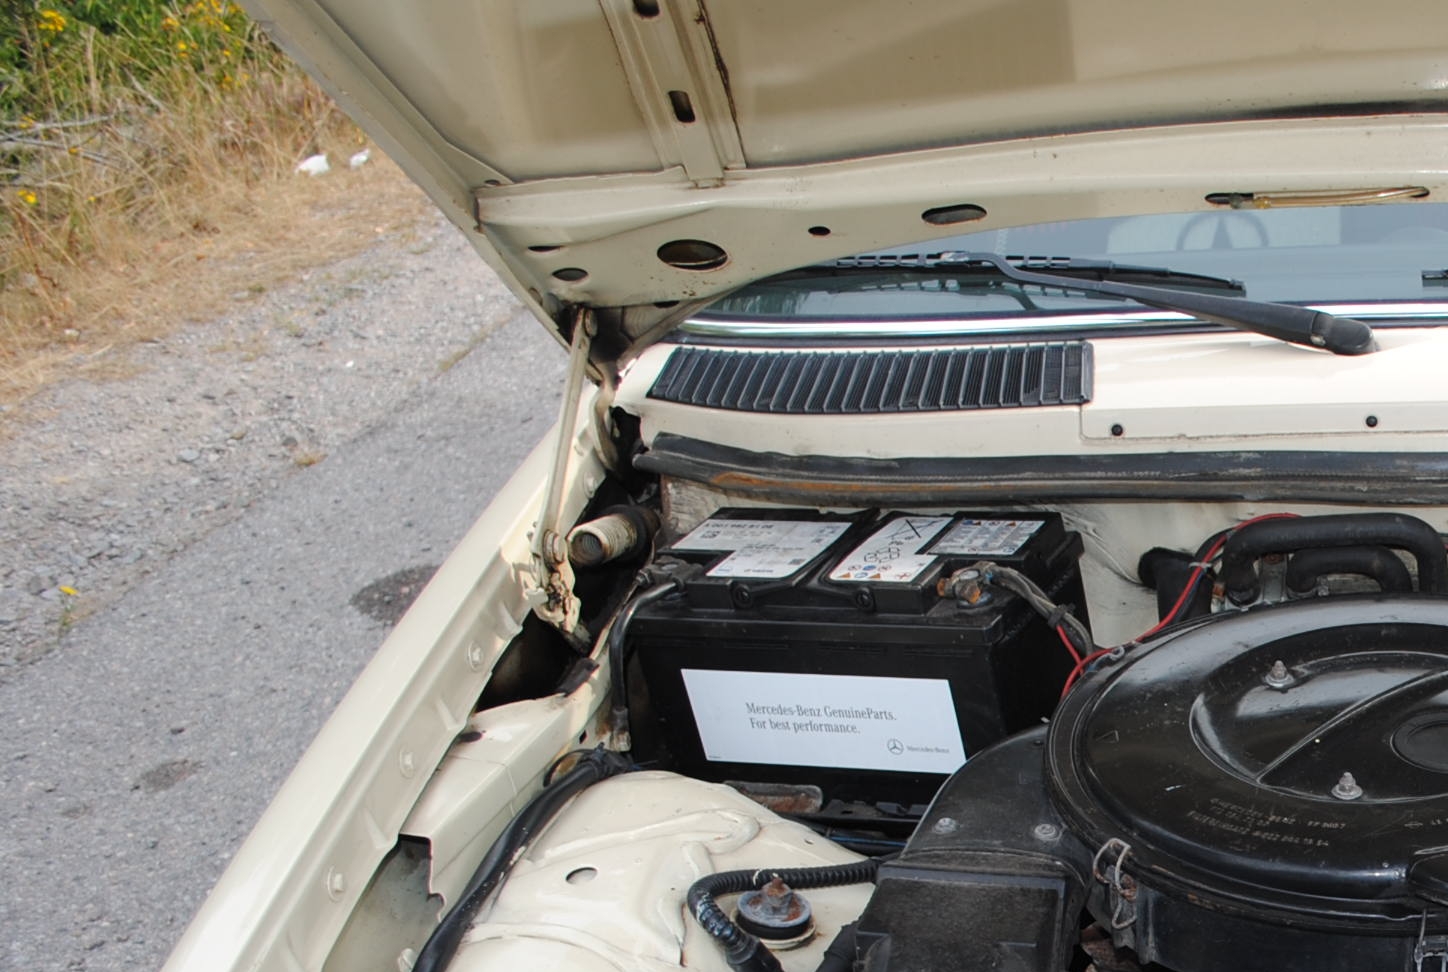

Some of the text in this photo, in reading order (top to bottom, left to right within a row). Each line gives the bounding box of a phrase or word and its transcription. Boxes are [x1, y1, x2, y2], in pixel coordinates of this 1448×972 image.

[746, 702, 822, 718] Mercedes-Benz
[749, 718, 861, 735] For best performance.
